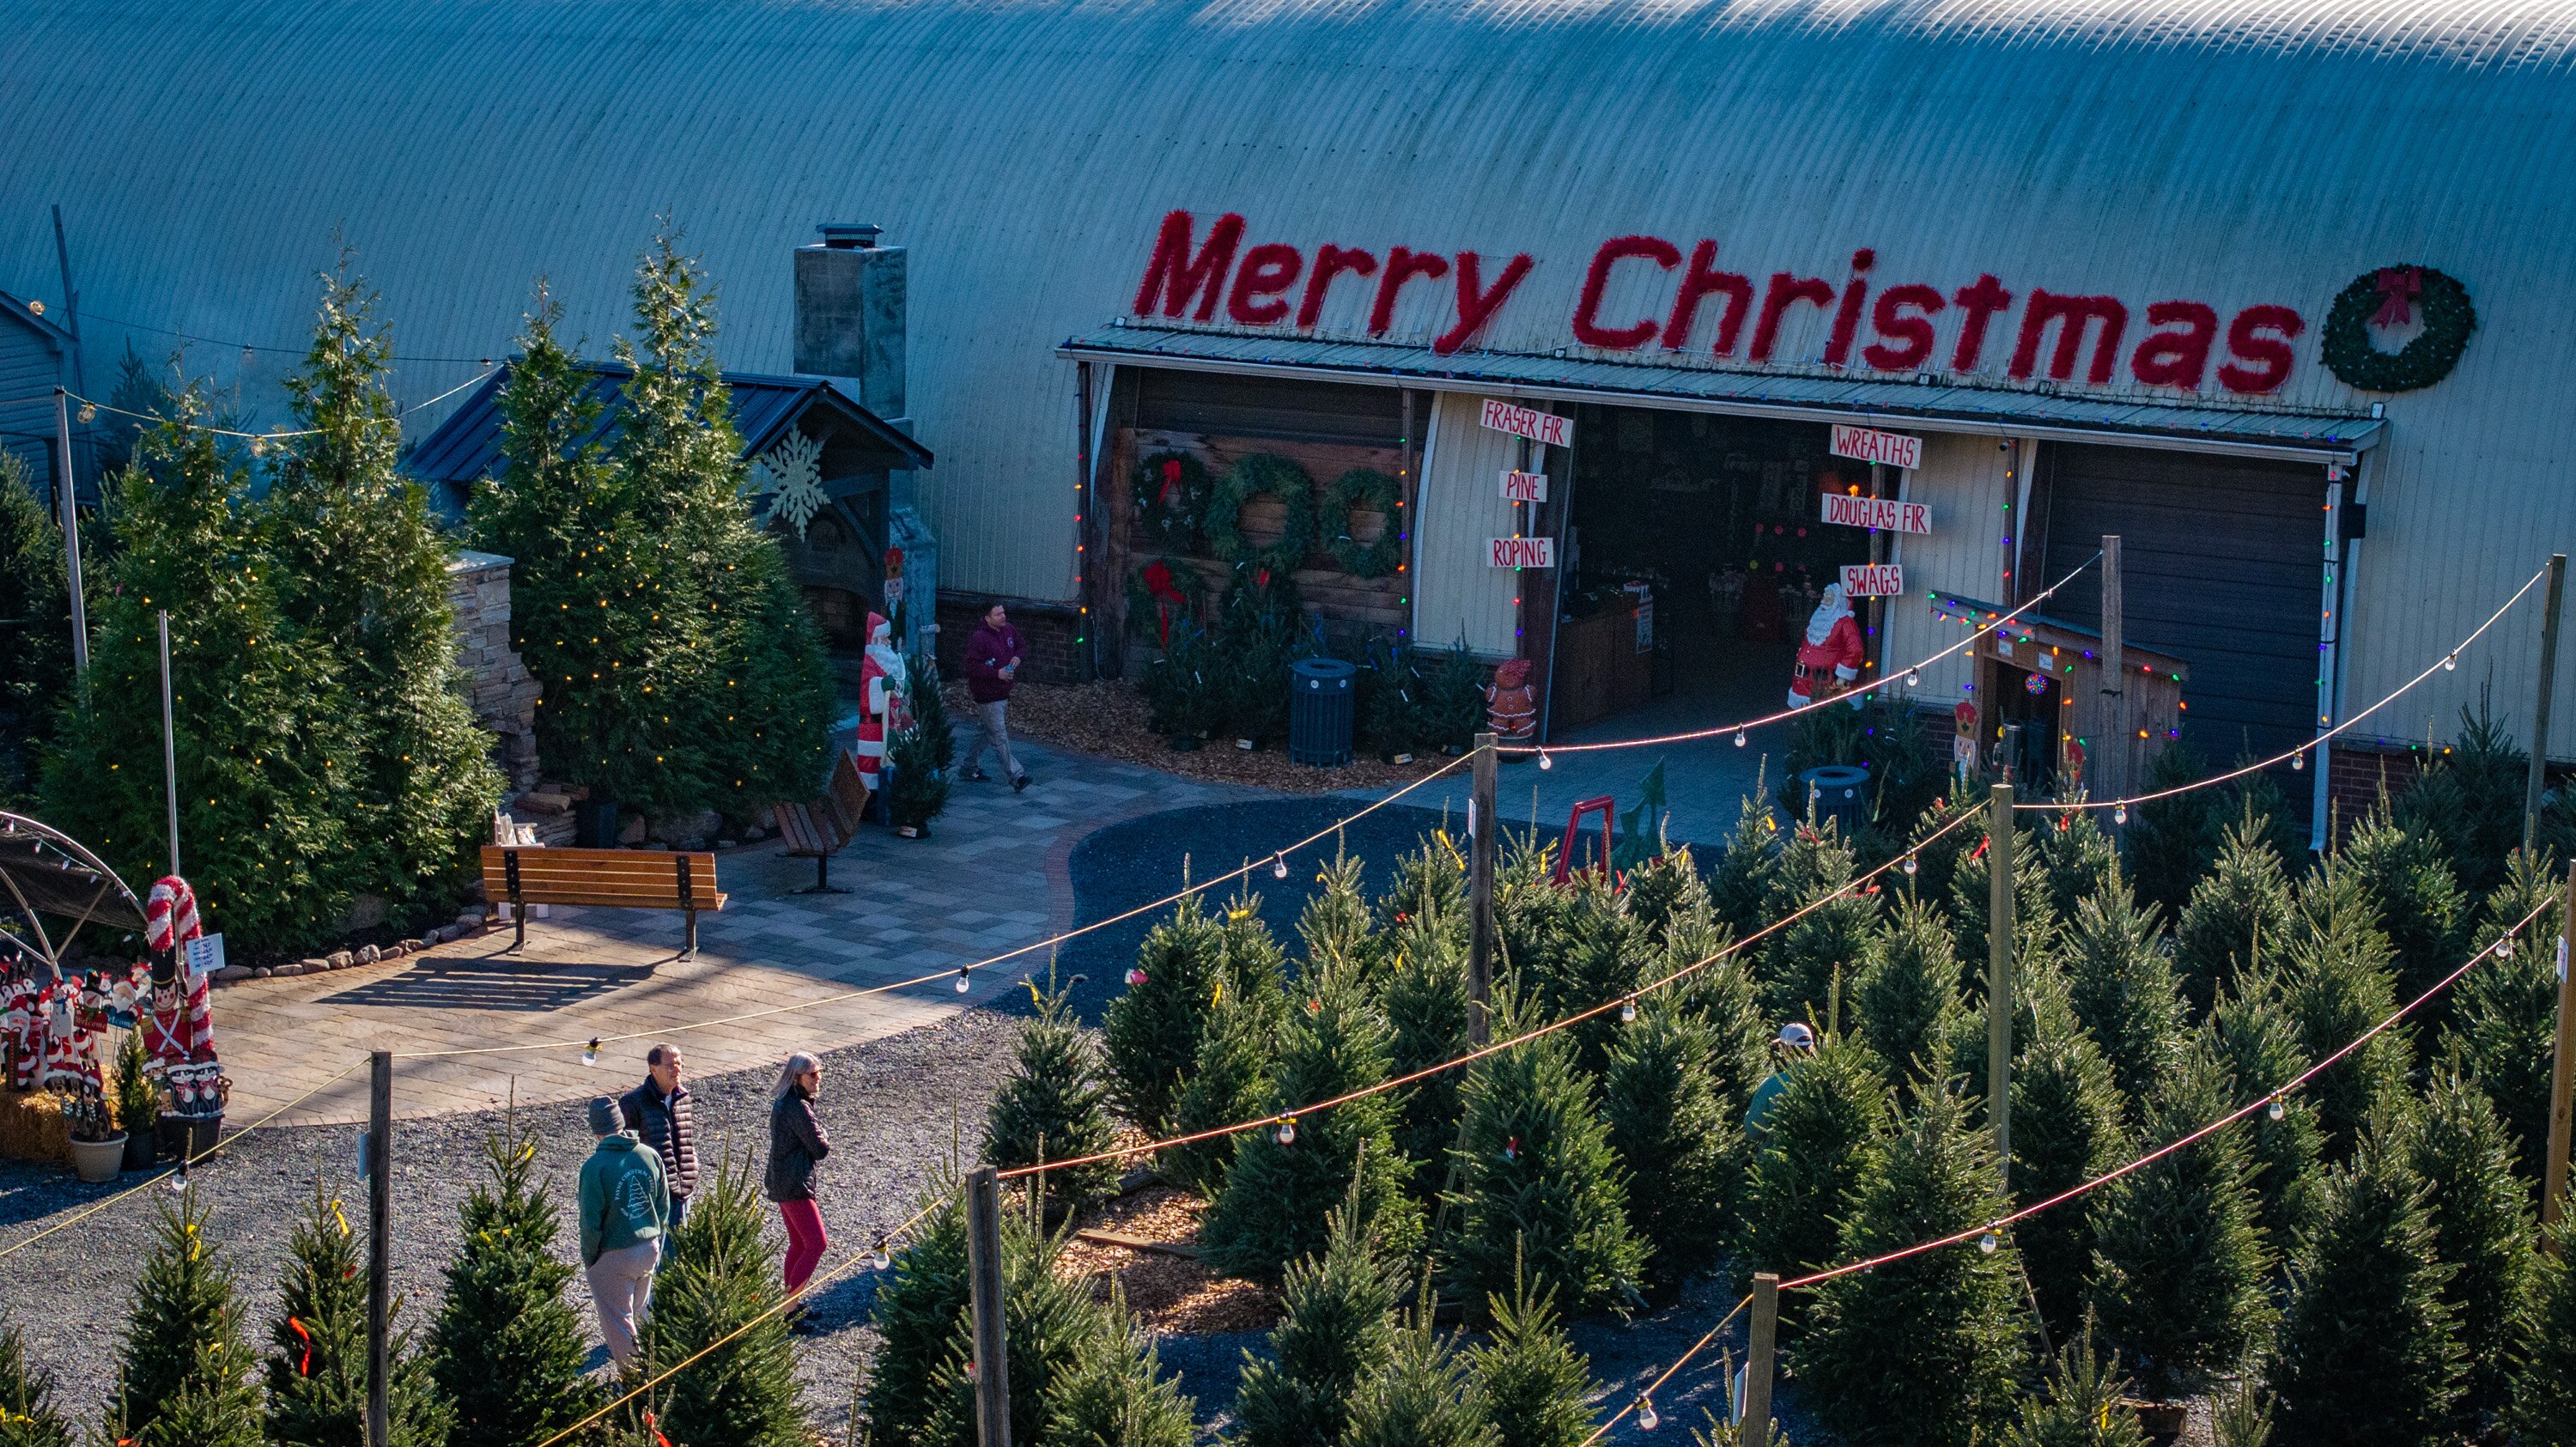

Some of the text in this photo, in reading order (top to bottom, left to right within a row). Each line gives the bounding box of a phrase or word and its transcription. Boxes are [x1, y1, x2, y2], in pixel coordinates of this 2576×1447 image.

[1134, 210, 2304, 395] Merry Christmas
[1484, 400, 1563, 445] FRASER FIR
[1836, 426, 1915, 467] WREATHS
[1506, 472, 1540, 501] PINE
[1830, 496, 1896, 530] DOUGLAS
[1902, 504, 1927, 533] FIR
[1493, 538, 1546, 567] ROPING
[1846, 566, 1900, 595] SWAGS
[76, 1016, 106, 1030] Welcome
